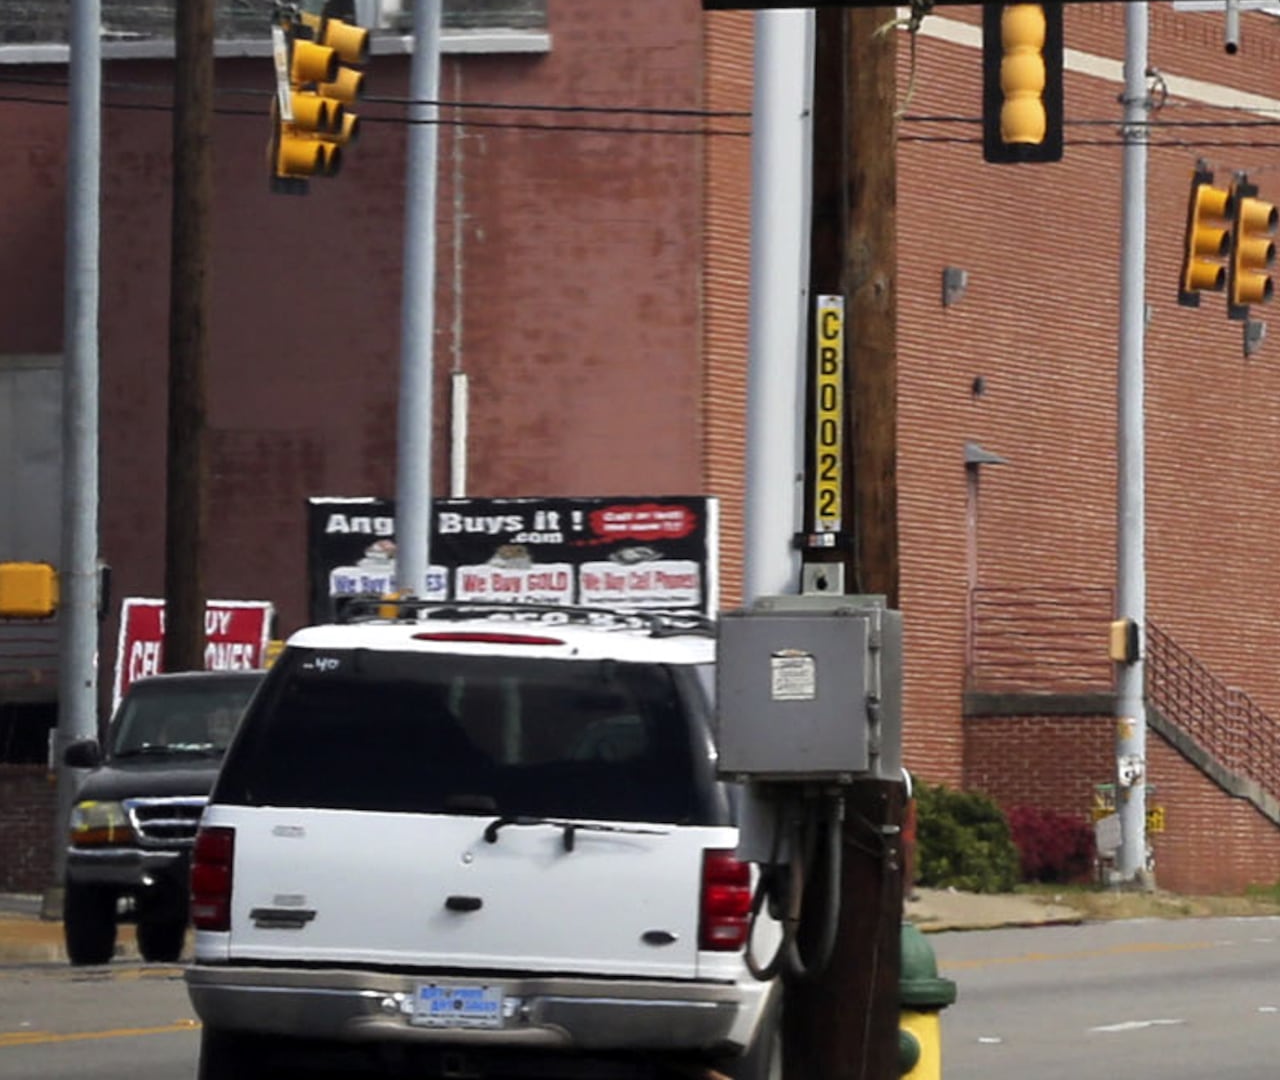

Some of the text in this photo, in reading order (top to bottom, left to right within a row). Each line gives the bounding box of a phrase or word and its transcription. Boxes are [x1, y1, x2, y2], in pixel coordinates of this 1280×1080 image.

[326, 513, 394, 536] Ang
[438, 512, 524, 535] Buys
[463, 574, 486, 592] We
[491, 573, 521, 593] Buy
[527, 572, 567, 591] GOLD
[205, 610, 231, 635] UY
